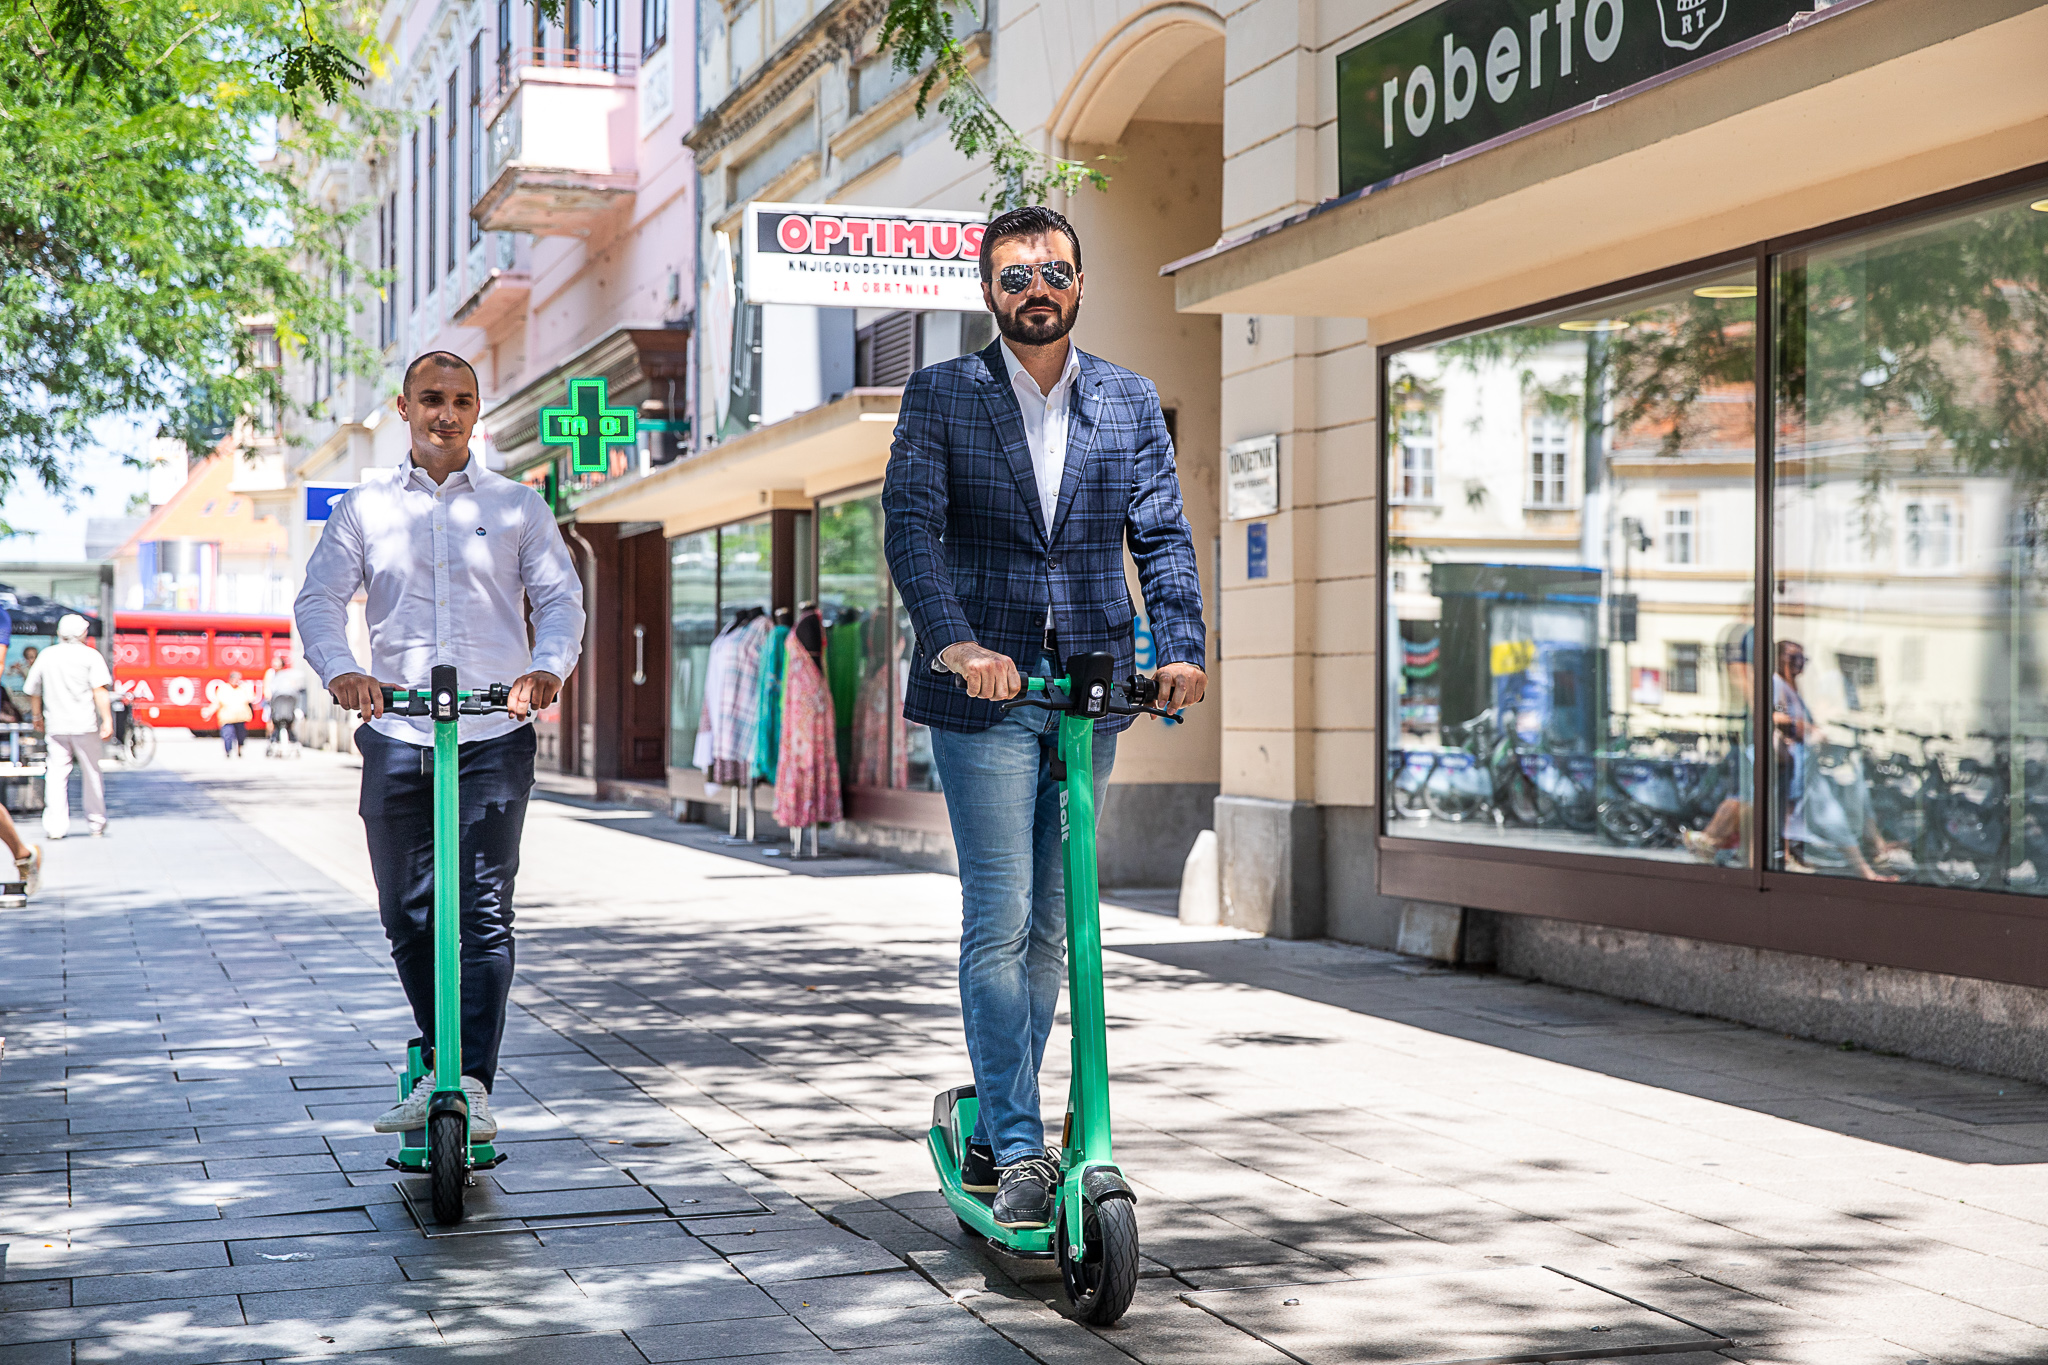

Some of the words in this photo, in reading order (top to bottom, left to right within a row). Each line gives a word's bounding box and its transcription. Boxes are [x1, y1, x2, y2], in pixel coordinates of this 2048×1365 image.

[1384, 0, 1623, 149] roberto
[777, 214, 988, 262] OPTIMUS
[788, 260, 925, 276] KNJIGOVODSTVENI
[929, 265, 980, 279] SERVIS
[1060, 789, 1070, 843] Bolt
